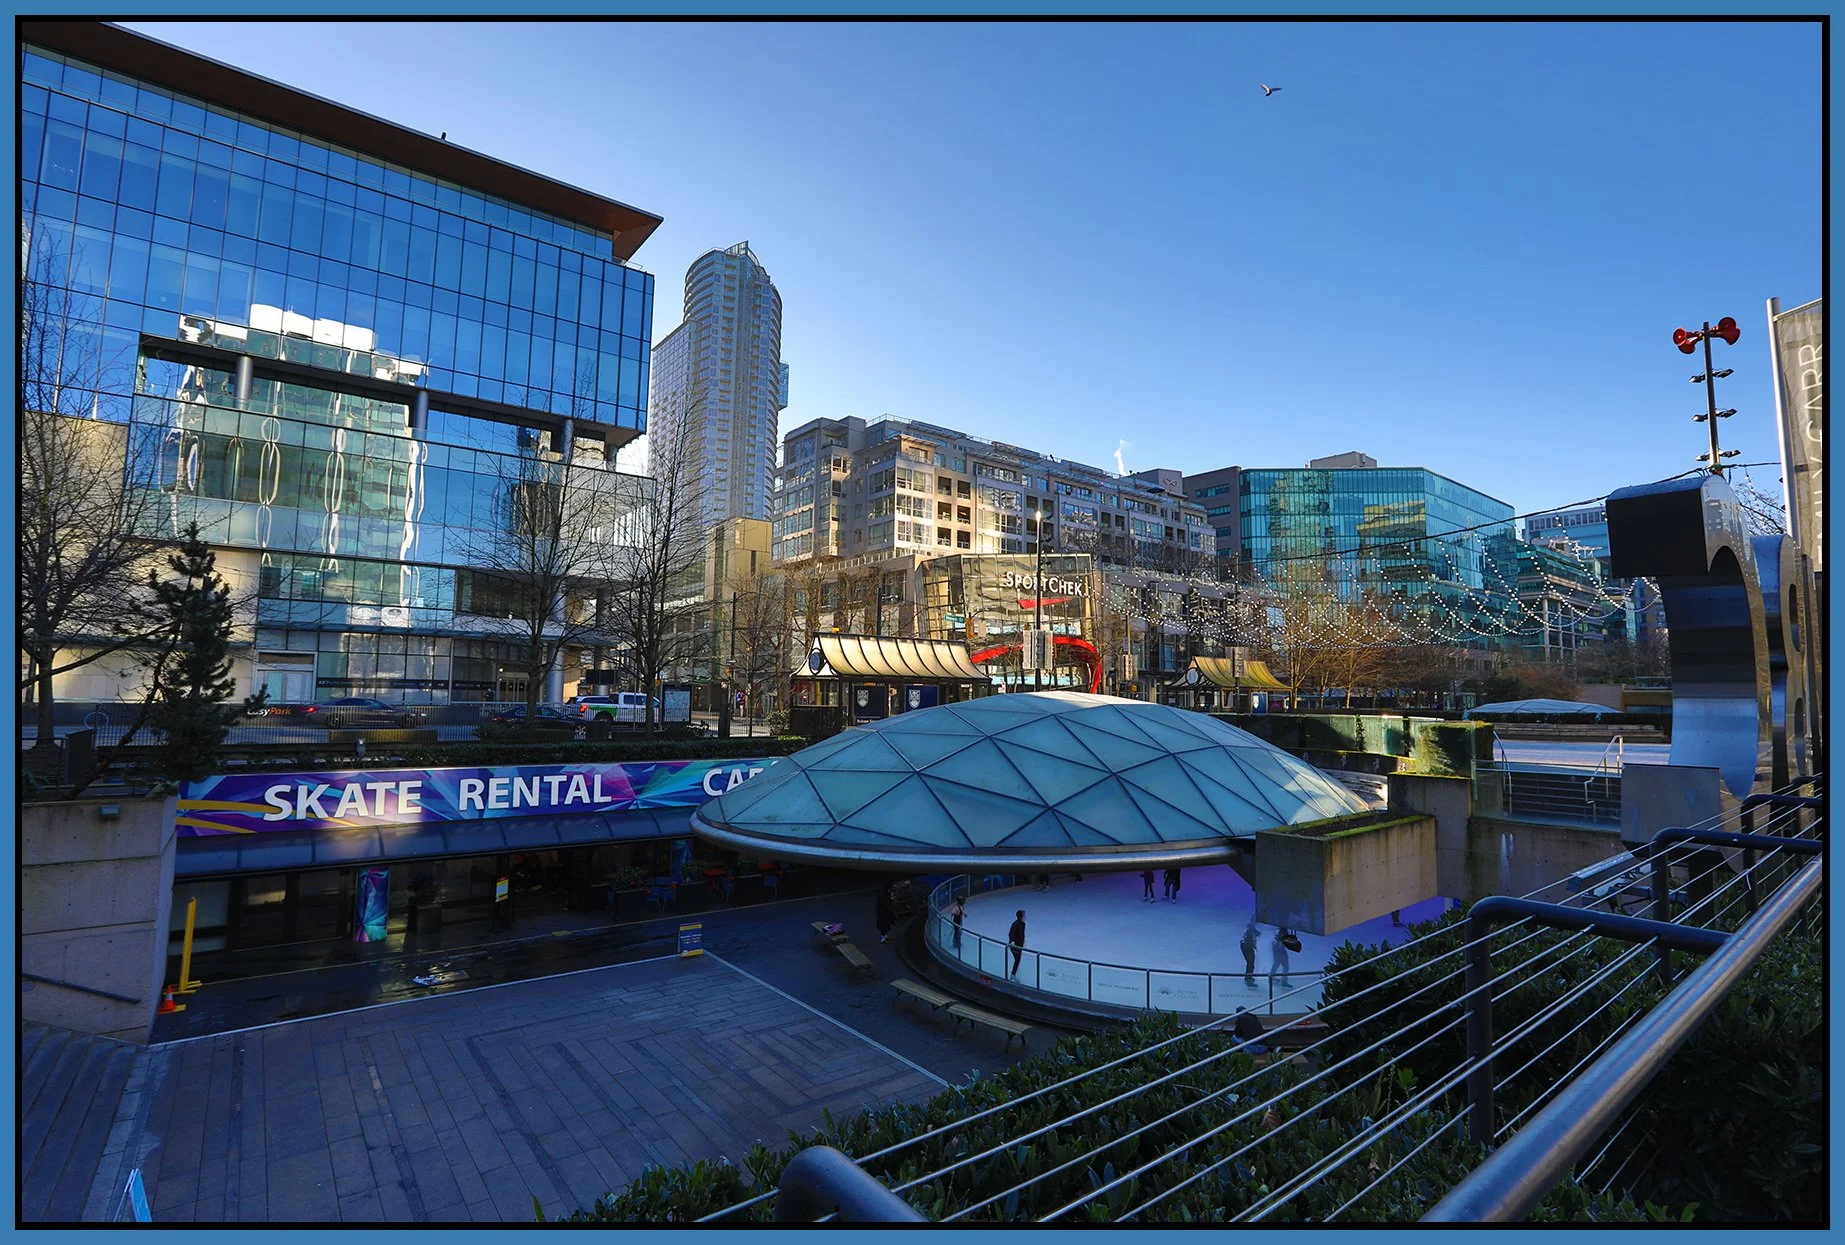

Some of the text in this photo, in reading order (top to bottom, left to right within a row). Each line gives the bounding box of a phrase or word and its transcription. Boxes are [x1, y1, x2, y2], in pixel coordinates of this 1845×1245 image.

[262, 760, 779, 822] SKATE RENTAL CA
